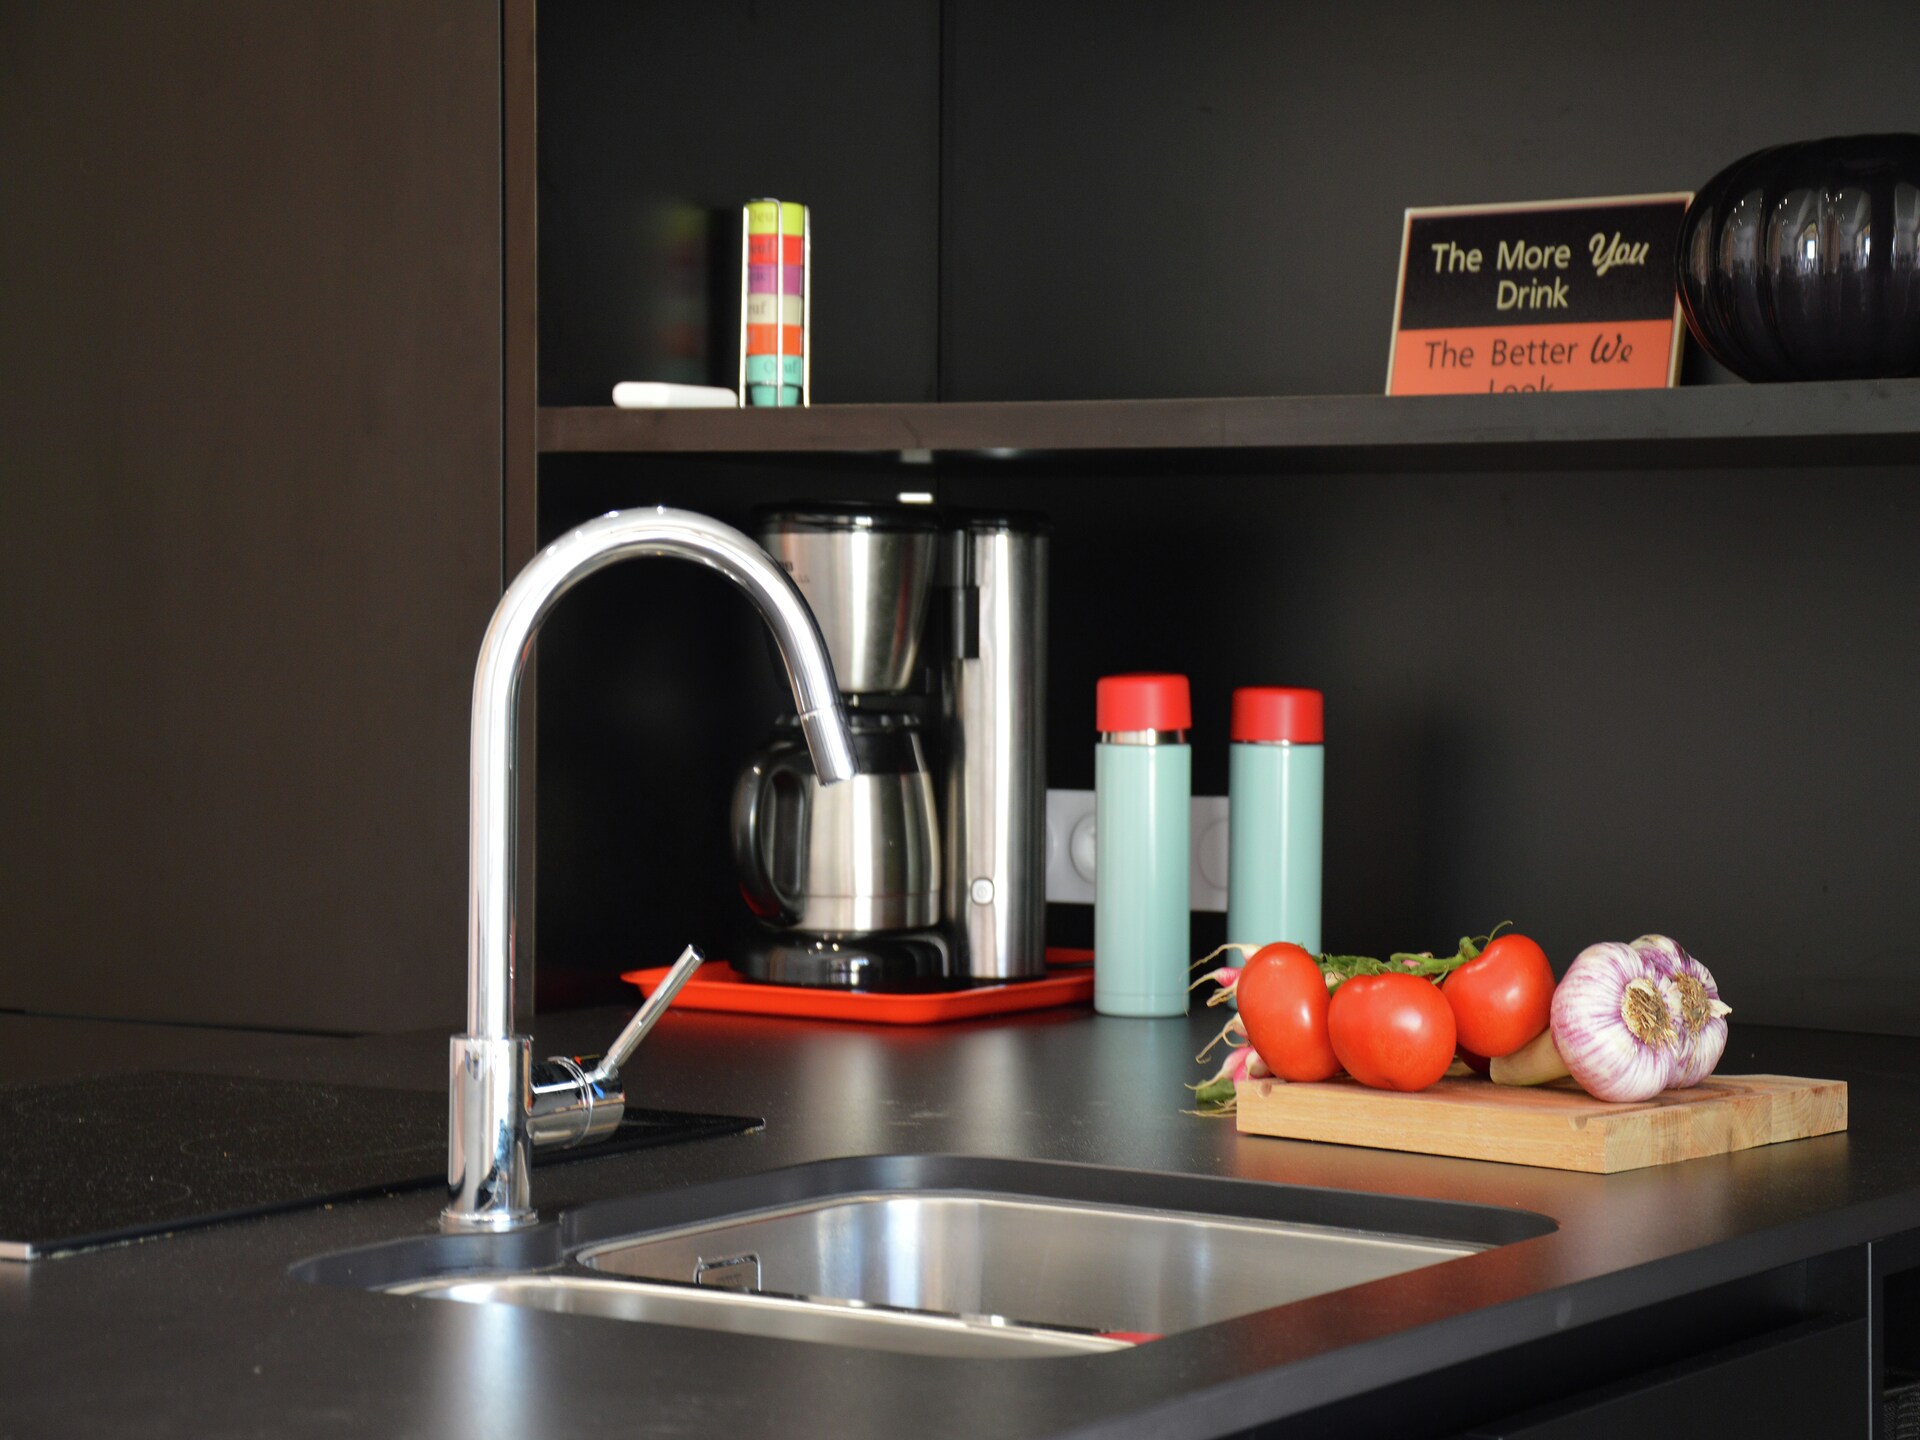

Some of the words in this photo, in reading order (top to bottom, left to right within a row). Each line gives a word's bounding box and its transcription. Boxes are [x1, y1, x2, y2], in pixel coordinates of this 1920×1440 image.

[1432, 241, 1483, 273] The
[1496, 240, 1571, 271] More
[1588, 231, 1650, 277] You
[1496, 276, 1570, 310] Drink
[763, 359, 798, 374] Ouf
[1425, 339, 1474, 368] The
[1491, 338, 1578, 366] Better
[1590, 333, 1633, 364] We
